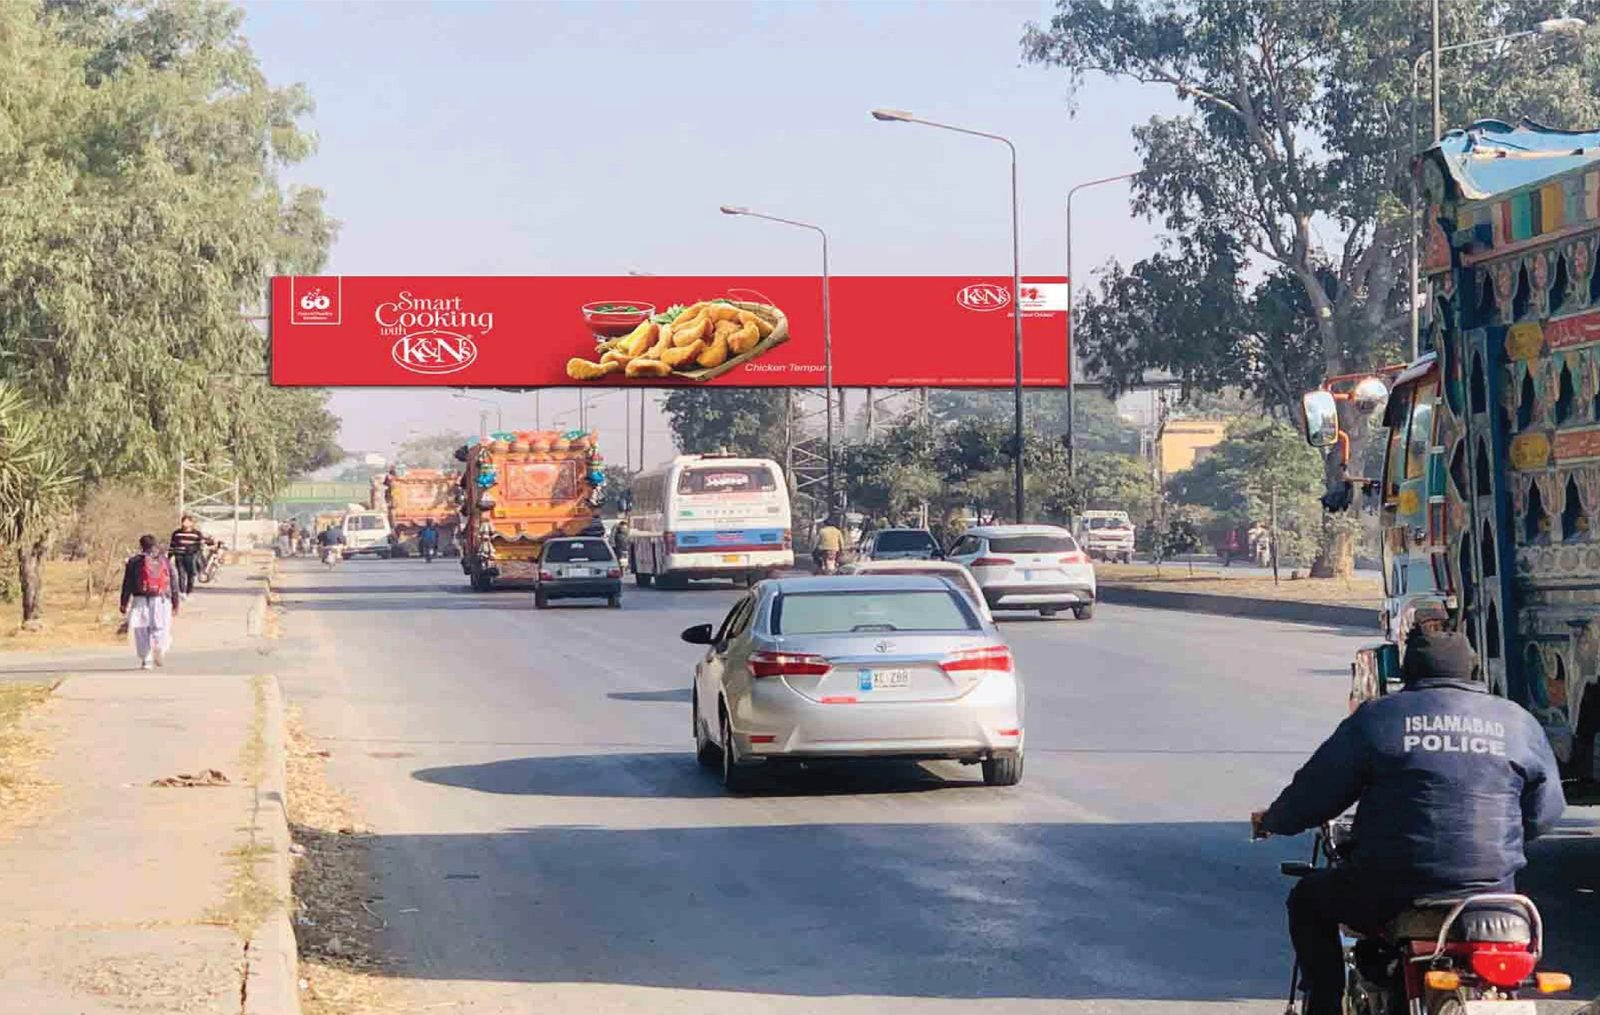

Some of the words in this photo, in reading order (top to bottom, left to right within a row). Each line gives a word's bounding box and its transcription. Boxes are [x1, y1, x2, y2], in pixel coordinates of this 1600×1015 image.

[301, 295, 330, 310] 60
[398, 290, 462, 311] Smart
[375, 302, 493, 334] Cooking
[380, 324, 407, 336] with
[744, 363, 786, 372] Chicken
[1405, 715, 1505, 738] ISLAMABAD
[1403, 734, 1506, 756] POLICE
